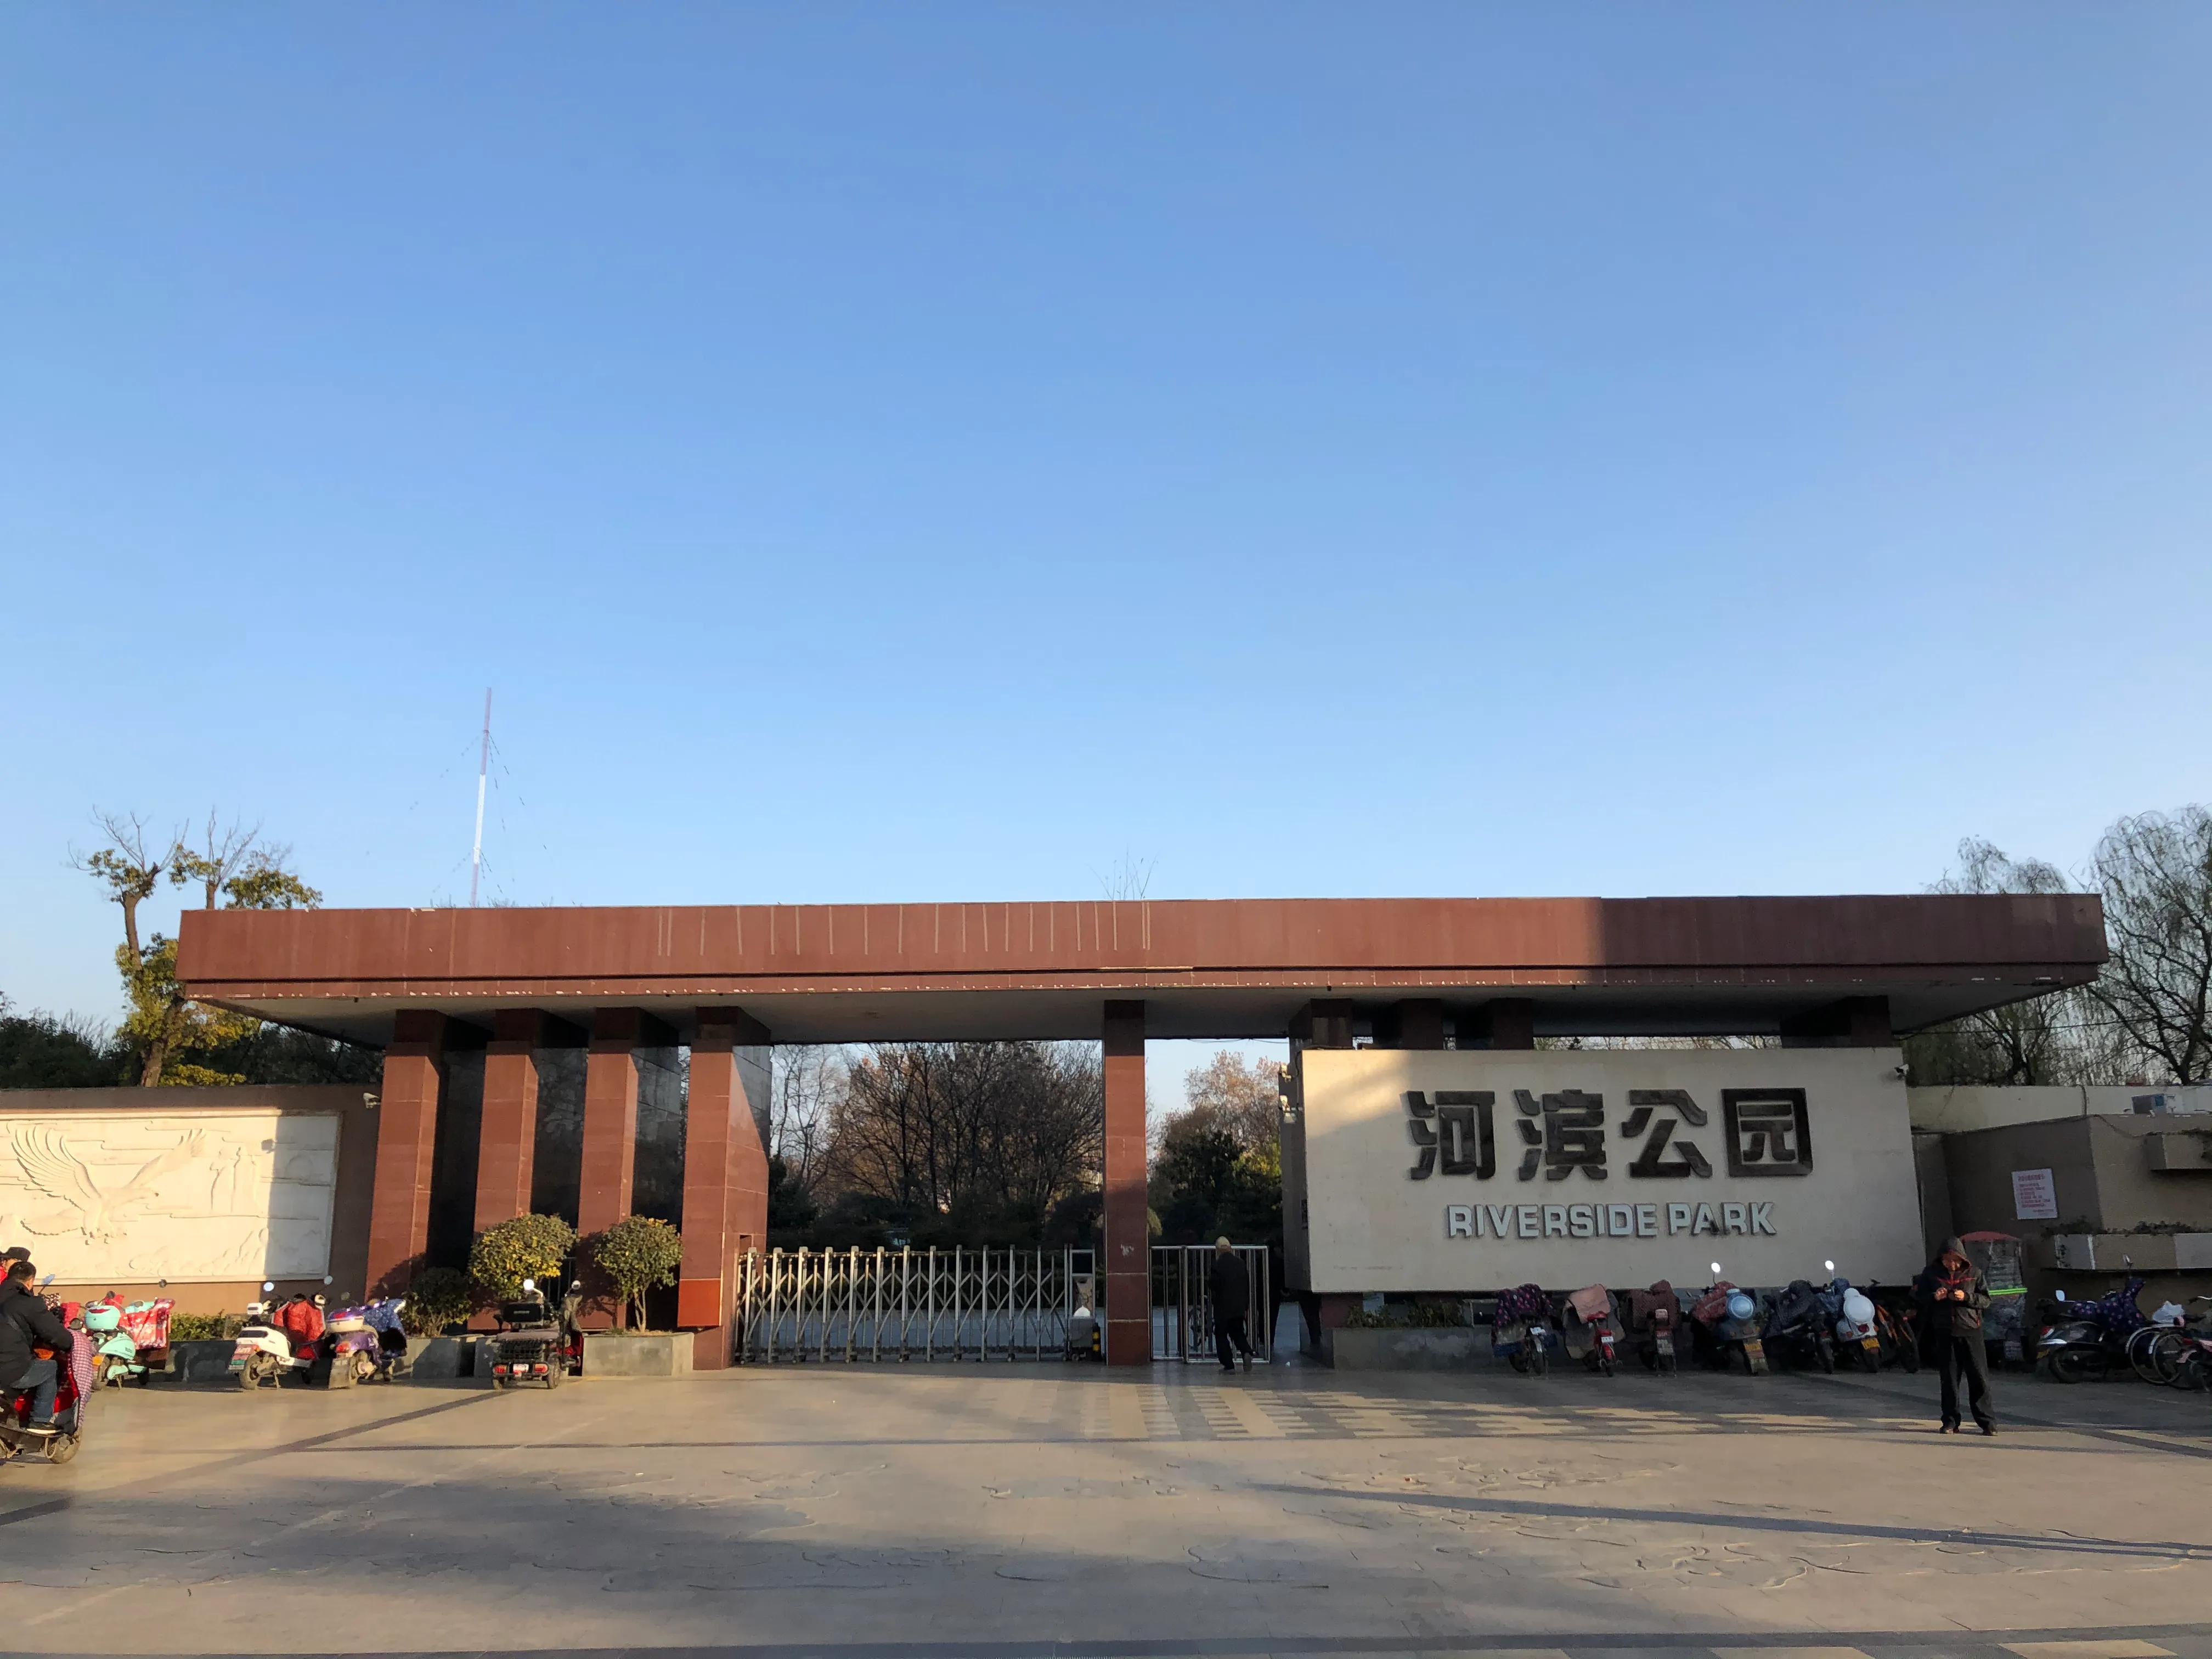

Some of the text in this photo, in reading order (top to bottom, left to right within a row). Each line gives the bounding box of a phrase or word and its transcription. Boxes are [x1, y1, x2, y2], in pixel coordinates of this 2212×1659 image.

[1407, 1087, 1813, 1179] 河滨公园
[1447, 1201, 1778, 1238] RIVERSIDE PARK
